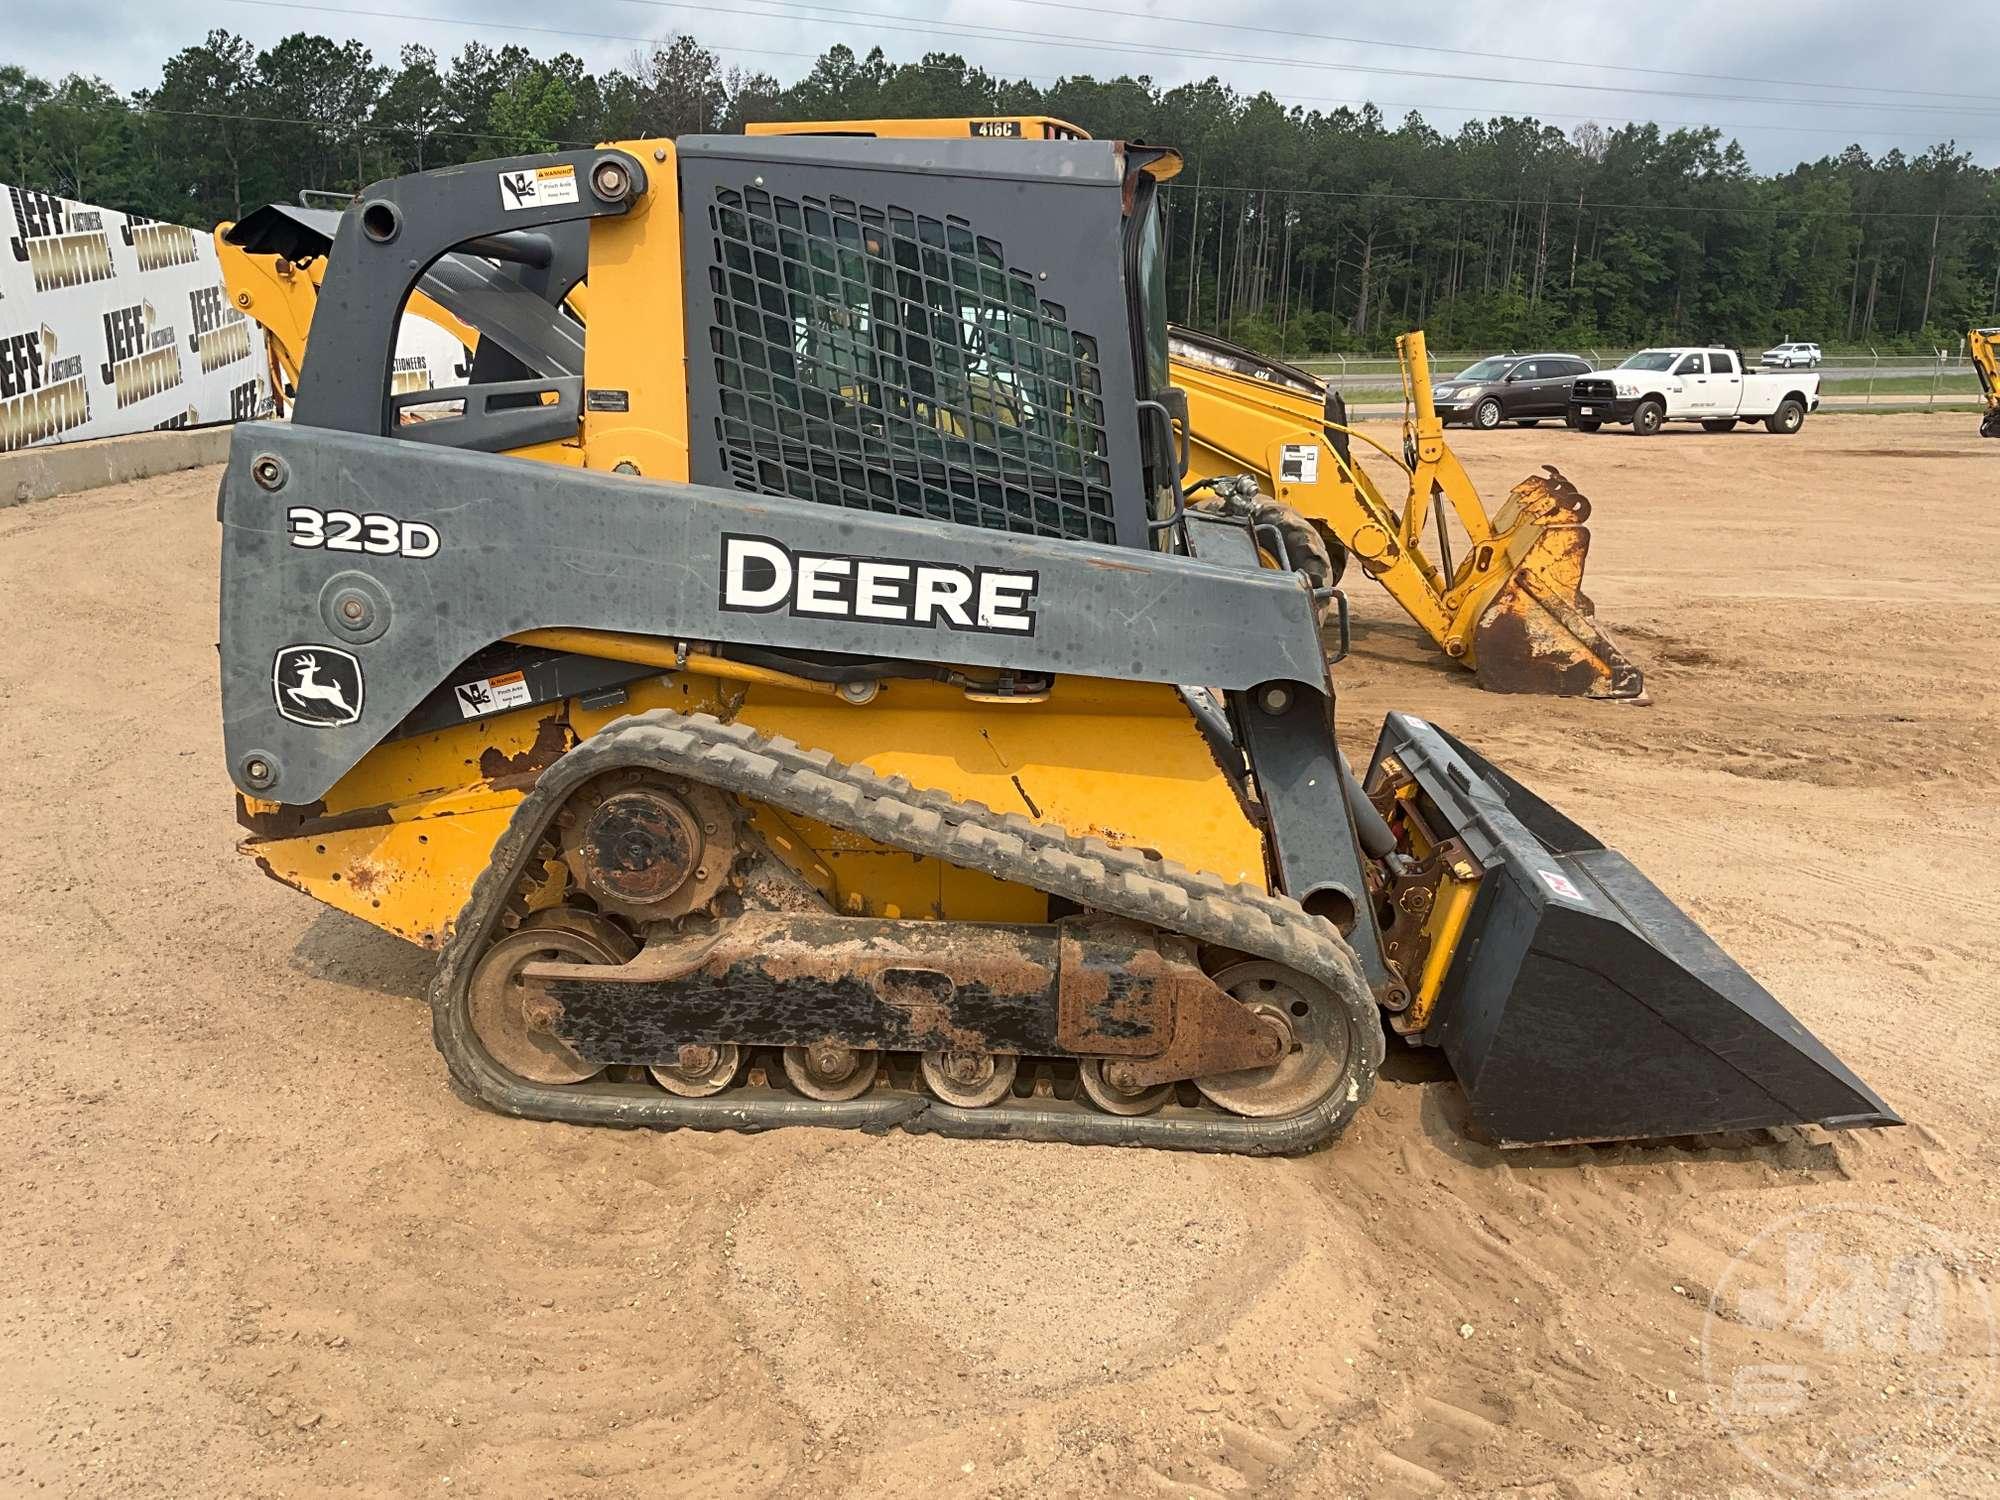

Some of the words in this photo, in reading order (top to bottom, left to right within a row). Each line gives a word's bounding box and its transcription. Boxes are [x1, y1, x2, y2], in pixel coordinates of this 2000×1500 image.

[979, 122, 1012, 136] 416C
[9, 187, 63, 261] JEFF
[132, 224, 195, 272] MARTIN
[27, 233, 112, 293] MARTIN
[101, 305, 145, 385] JEFF
[188, 286, 222, 353] JEFF
[0, 330, 42, 399] EFF
[114, 346, 179, 409] MARTIN
[394, 356, 427, 372] TIONEERS
[288, 507, 440, 559] 323D
[722, 535, 1036, 634] DEERE
